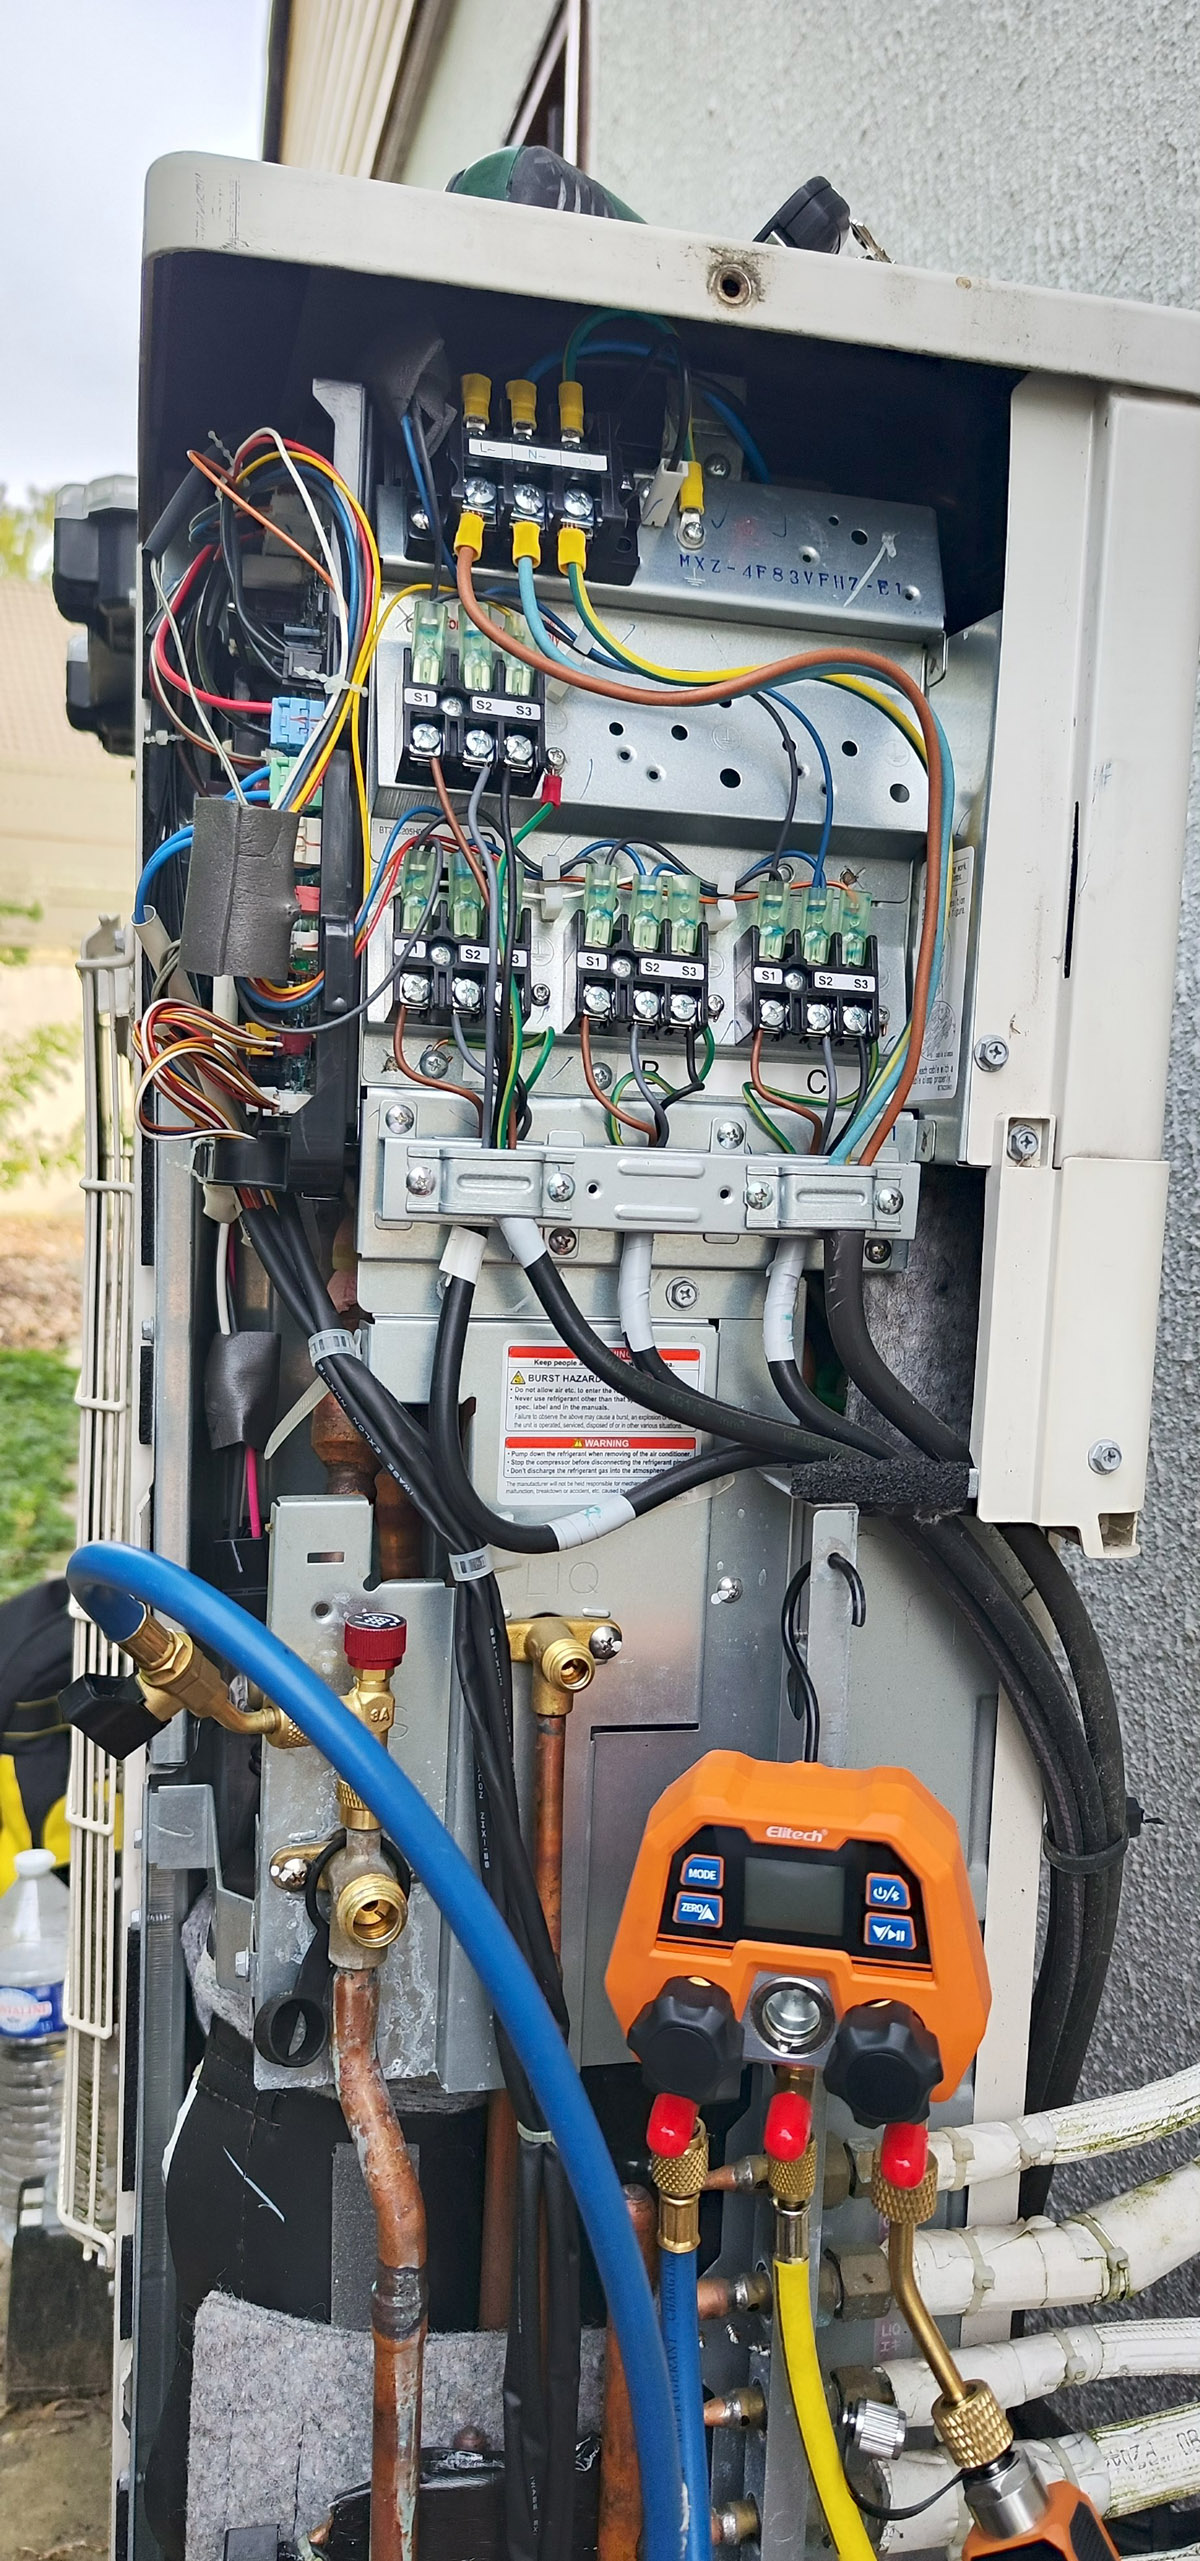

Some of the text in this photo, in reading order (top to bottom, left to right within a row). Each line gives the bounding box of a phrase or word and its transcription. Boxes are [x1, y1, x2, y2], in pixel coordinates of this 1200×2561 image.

[413, 692, 430, 703] S1
[476, 699, 533, 717] S2 S3
[465, 948, 482, 961] S2
[586, 956, 601, 967] S1
[645, 961, 697, 977] S2 S3
[761, 970, 776, 981] S1
[818, 975, 869, 990] S2 S3
[642, 1060, 660, 1086] B
[808, 1069, 828, 1095] C
[534, 1359, 553, 1368] Keep
[554, 1359, 577, 1367] people
[528, 1374, 601, 1383] BURST HAZARD
[547, 1395, 580, 1404] refrigerant
[515, 1404, 531, 1412] spec.
[587, 1414, 596, 1422] may
[638, 1414, 662, 1422] explosion
[539, 1422, 562, 1430] operated,
[563, 1422, 586, 1430] serviced,
[586, 1422, 610, 1431] disposed
[352, 1416, 382, 1455] EXLON
[585, 1439, 630, 1448] WARNING
[557, 1451, 588, 1459] refrigerant
[604, 1451, 632, 1459] removing
[511, 1459, 525, 1467] Stop
[536, 1459, 571, 1467] compressor
[590, 1459, 632, 1468] disconnecting
[642, 1459, 673, 1468] refrigerant
[527, 1467, 556, 1475] discharge
[567, 1467, 598, 1475] refrigerant
[386, 1463, 414, 1497] IWASE
[586, 1481, 613, 1489] responsible
[525, 1561, 600, 1597] LIQ
[766, 1825, 823, 1843] Elitech
[688, 1868, 717, 1881] MODE
[681, 1902, 704, 1914] ZERO
